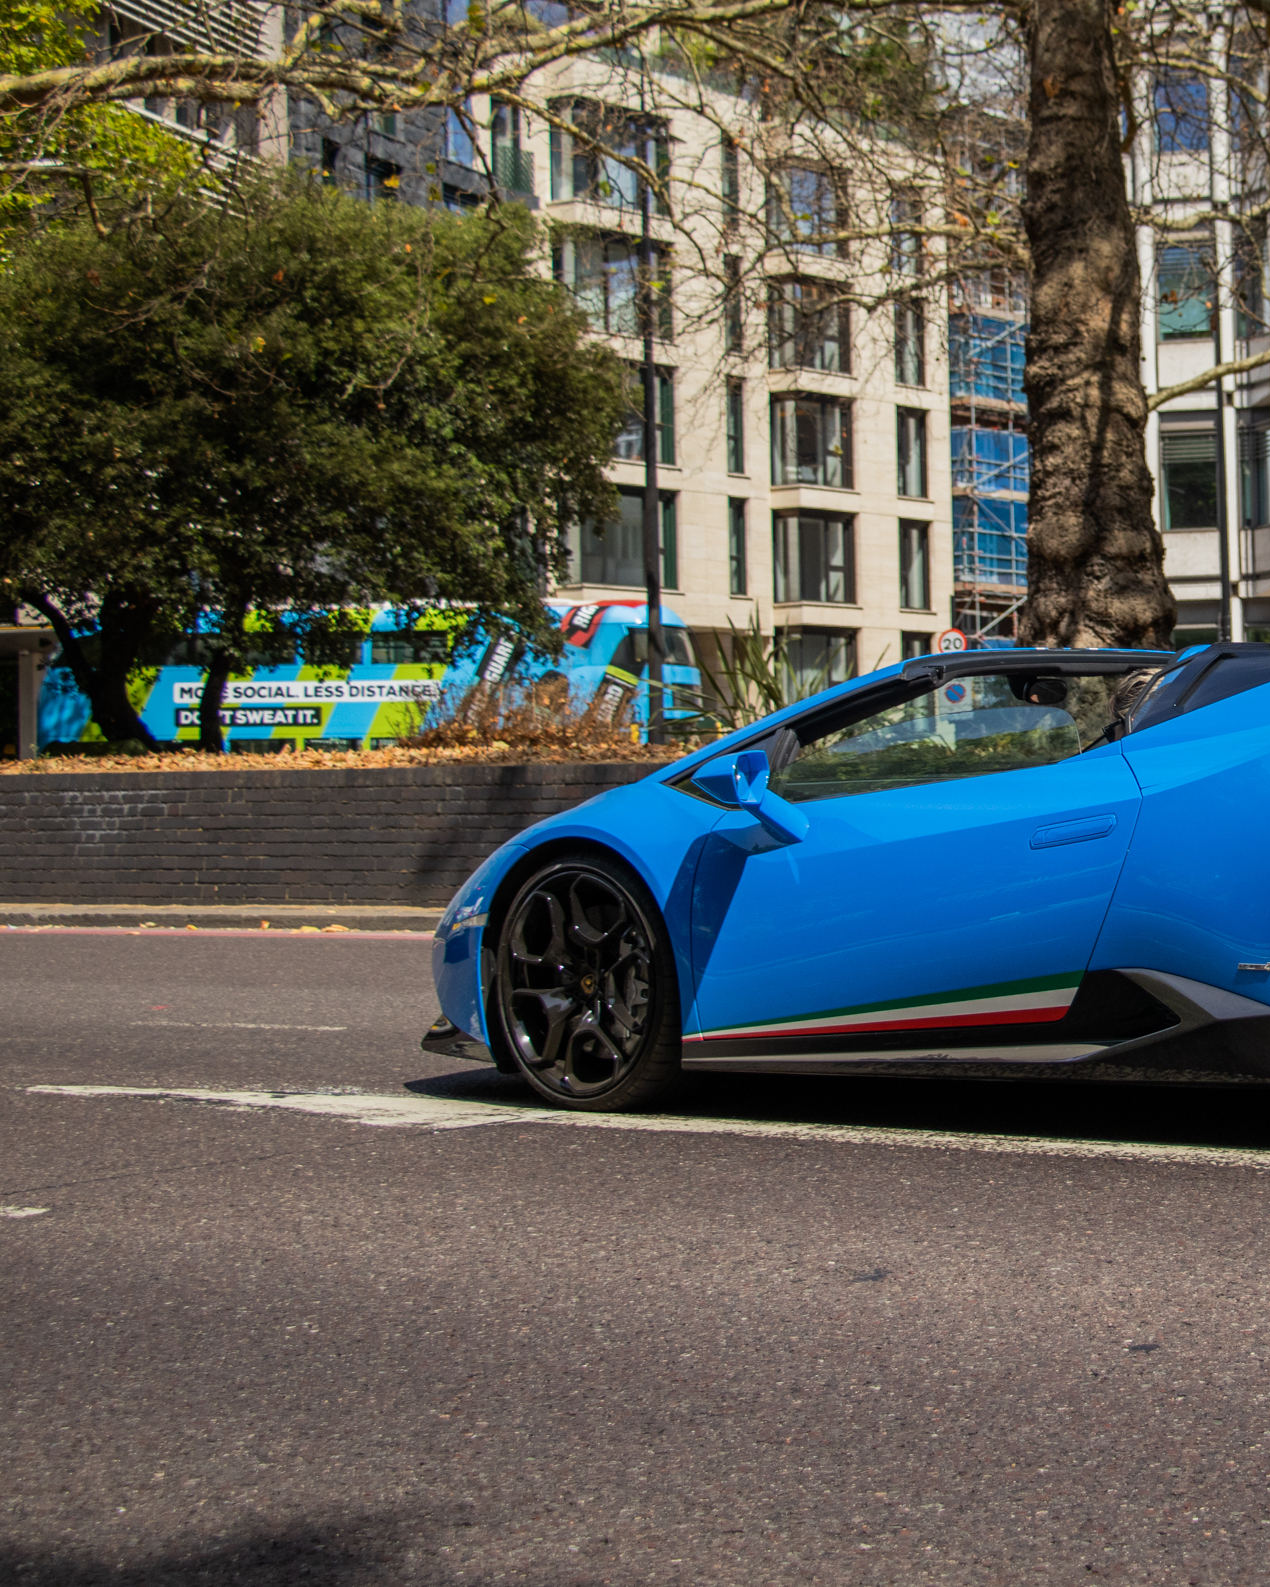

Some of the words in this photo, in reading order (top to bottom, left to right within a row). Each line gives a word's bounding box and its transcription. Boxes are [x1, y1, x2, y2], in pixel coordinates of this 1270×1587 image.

[572, 605, 599, 628] RIG
[942, 638, 962, 650] 20
[179, 686, 229, 699] MOE
[233, 685, 299, 699] SOCIAL.
[304, 685, 344, 698] LESS
[234, 709, 297, 724] SWEAT
[298, 709, 319, 724] IT.
